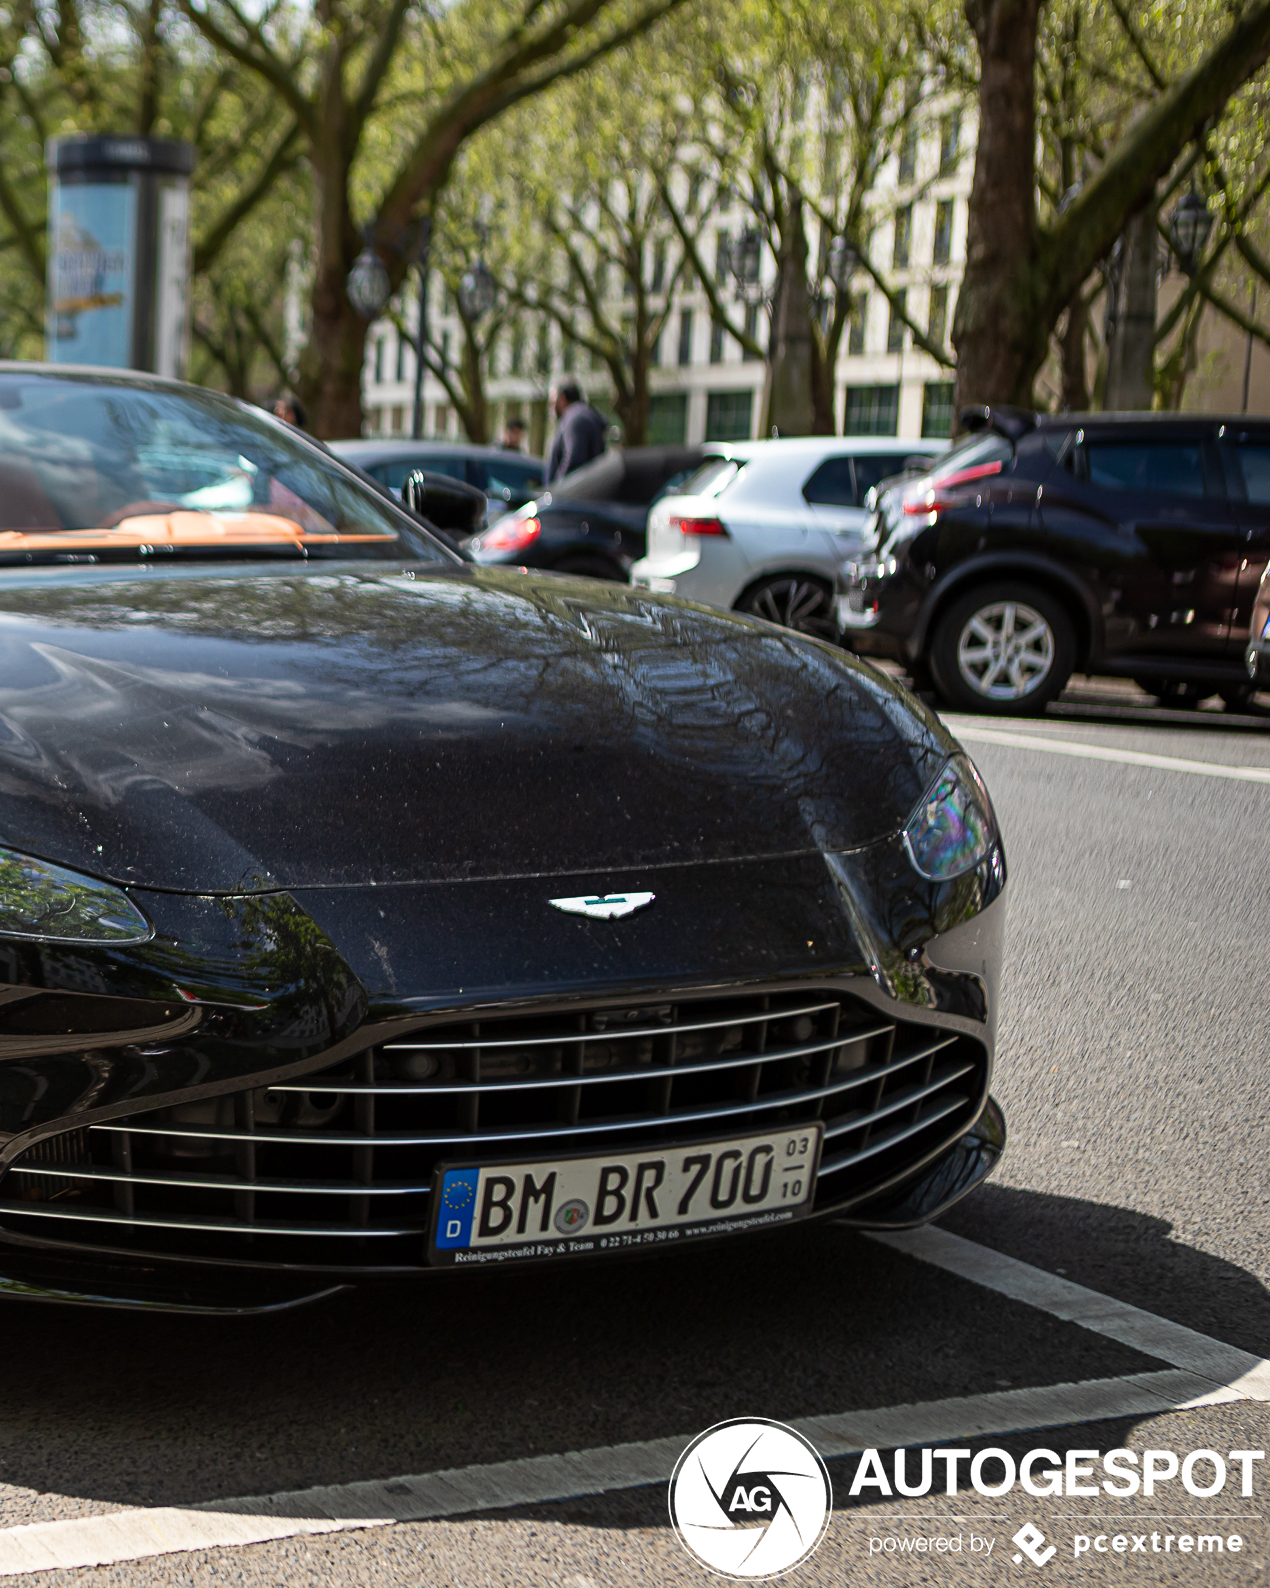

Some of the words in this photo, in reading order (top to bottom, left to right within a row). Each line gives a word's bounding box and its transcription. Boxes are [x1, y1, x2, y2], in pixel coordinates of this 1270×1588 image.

[786, 1137, 809, 1157] 03
[478, 1171, 557, 1238] BM
[593, 1160, 666, 1226] BR
[677, 1144, 774, 1216] 700
[782, 1179, 802, 1199] 10
[446, 1220, 461, 1238] D
[454, 1246, 535, 1263] Reinigungsteufel
[536, 1244, 555, 1257] Fay
[556, 1243, 567, 1253] &
[568, 1241, 594, 1252] Team
